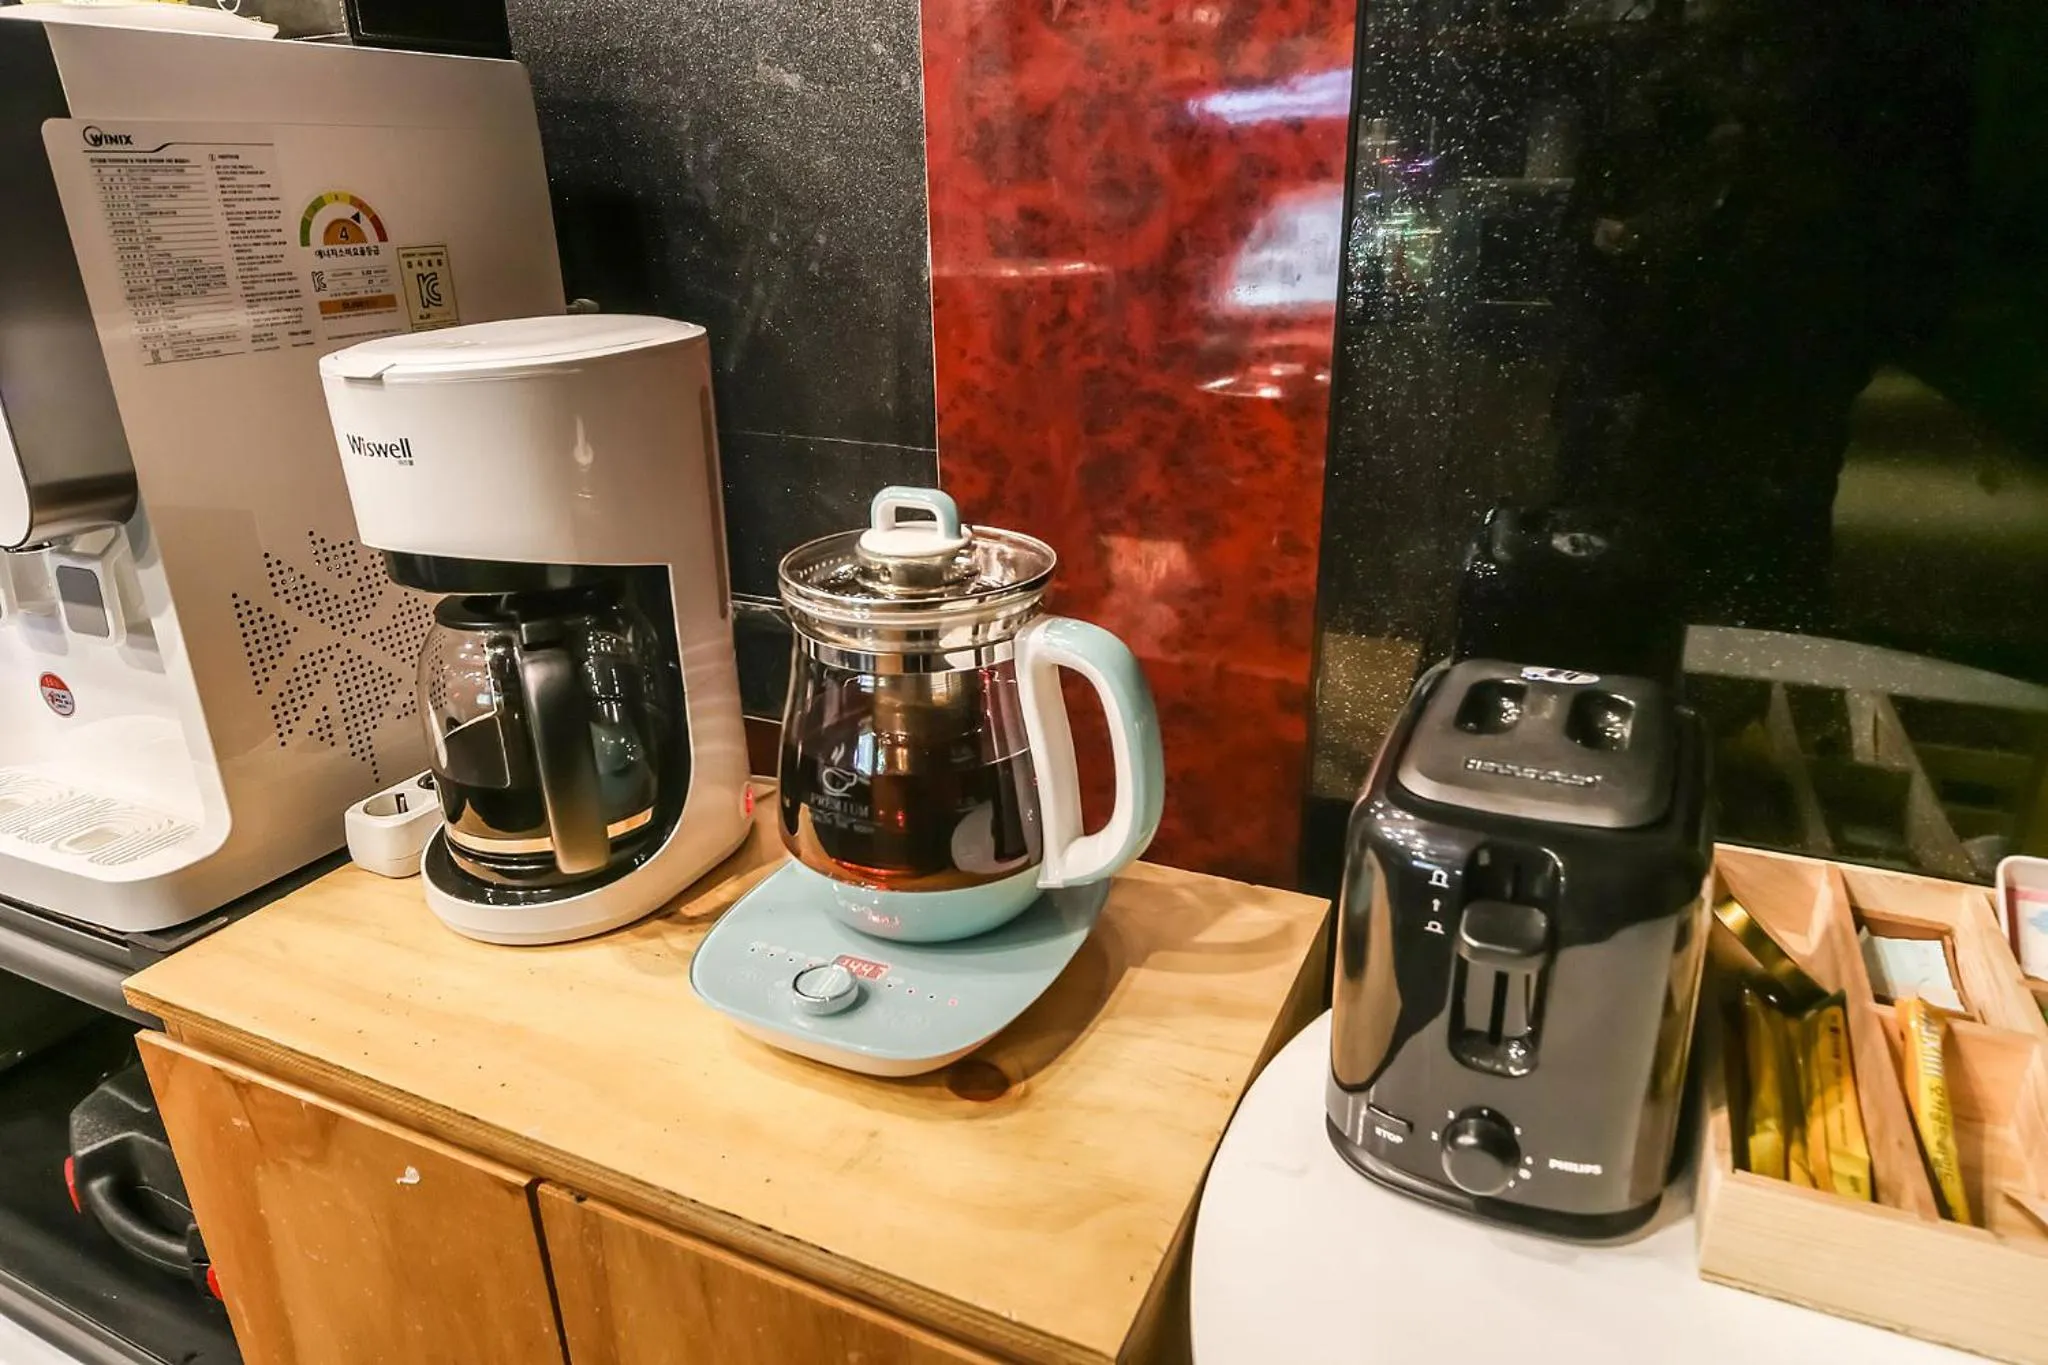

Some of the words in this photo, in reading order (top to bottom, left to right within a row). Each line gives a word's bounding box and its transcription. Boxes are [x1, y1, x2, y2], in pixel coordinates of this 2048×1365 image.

[86, 129, 133, 147] WINIX
[340, 227, 349, 241] 4
[346, 433, 412, 459] Wiswell
[1375, 1125, 1403, 1144] STOP
[1548, 1158, 1602, 1175] PHILIPS
